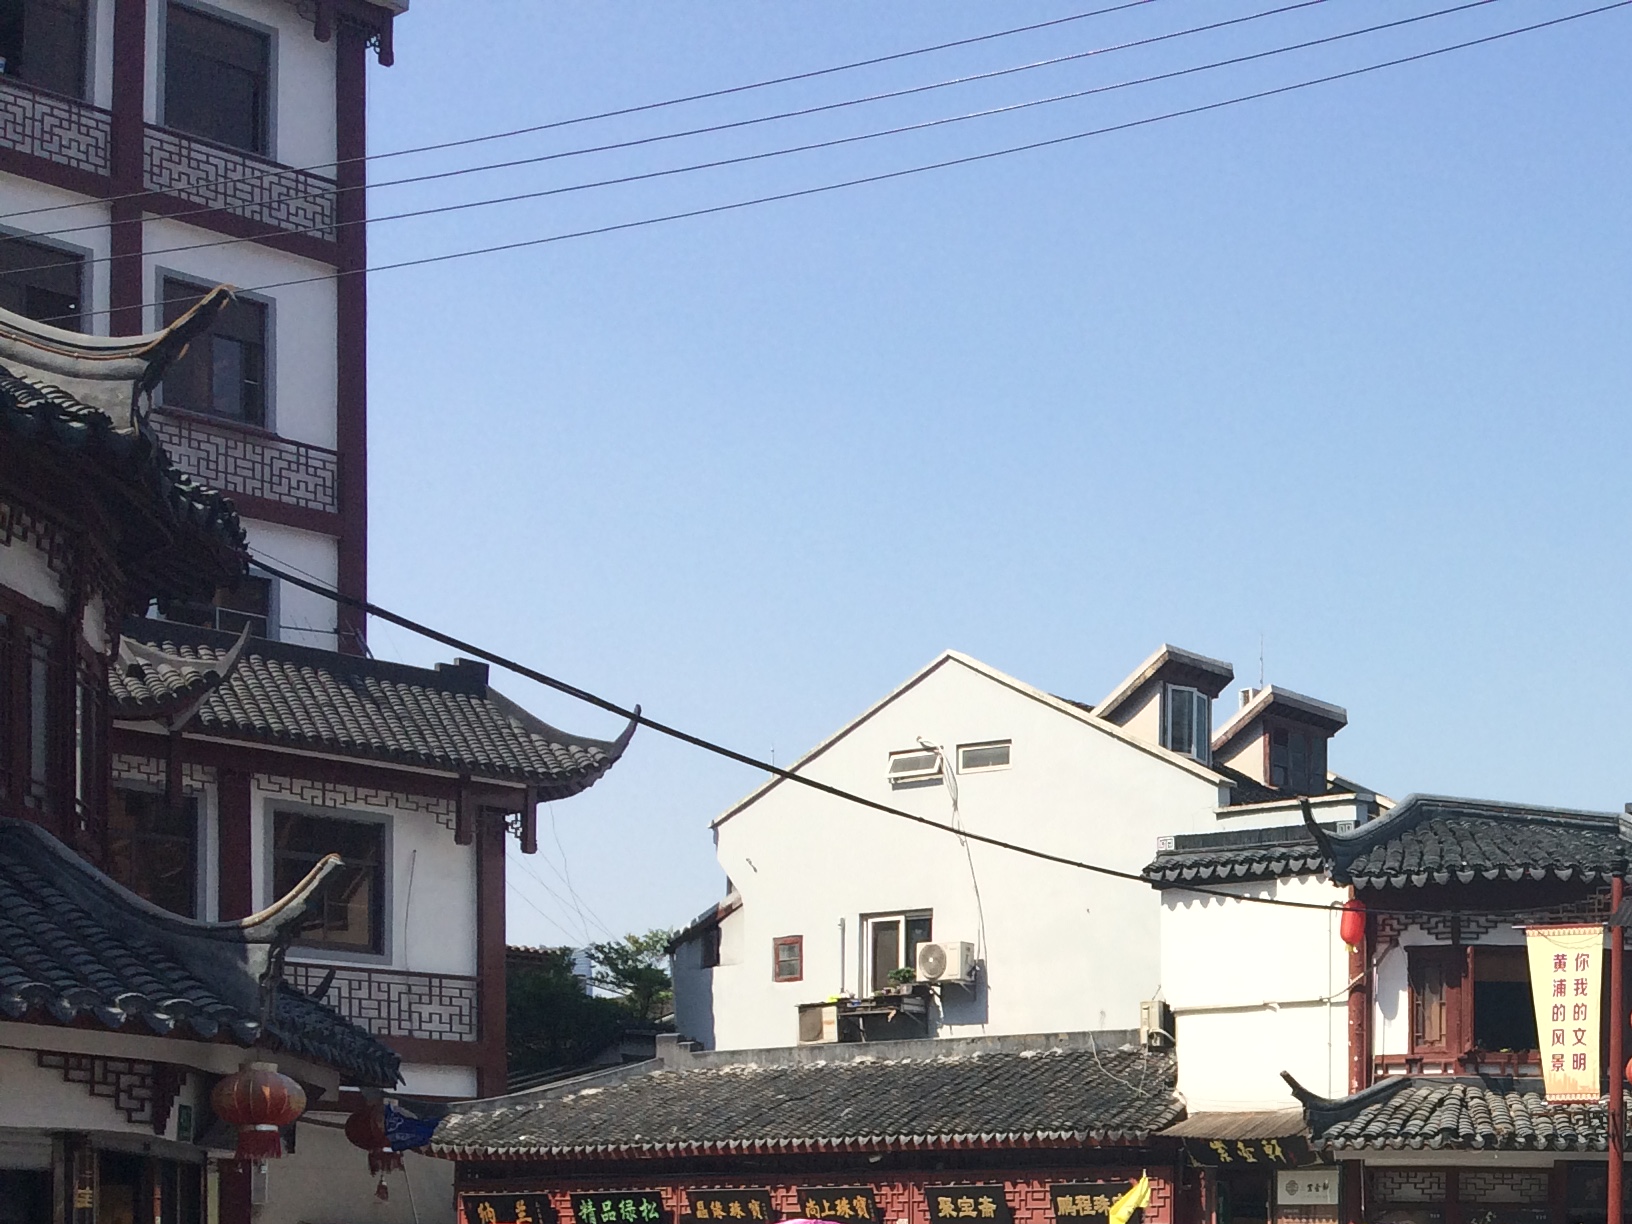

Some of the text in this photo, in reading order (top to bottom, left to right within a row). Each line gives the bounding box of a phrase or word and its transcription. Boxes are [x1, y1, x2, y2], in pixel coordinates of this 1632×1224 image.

[1551, 953, 1568, 1072] 黄浦的风景
[1572, 952, 1590, 1072] 你我的文明
